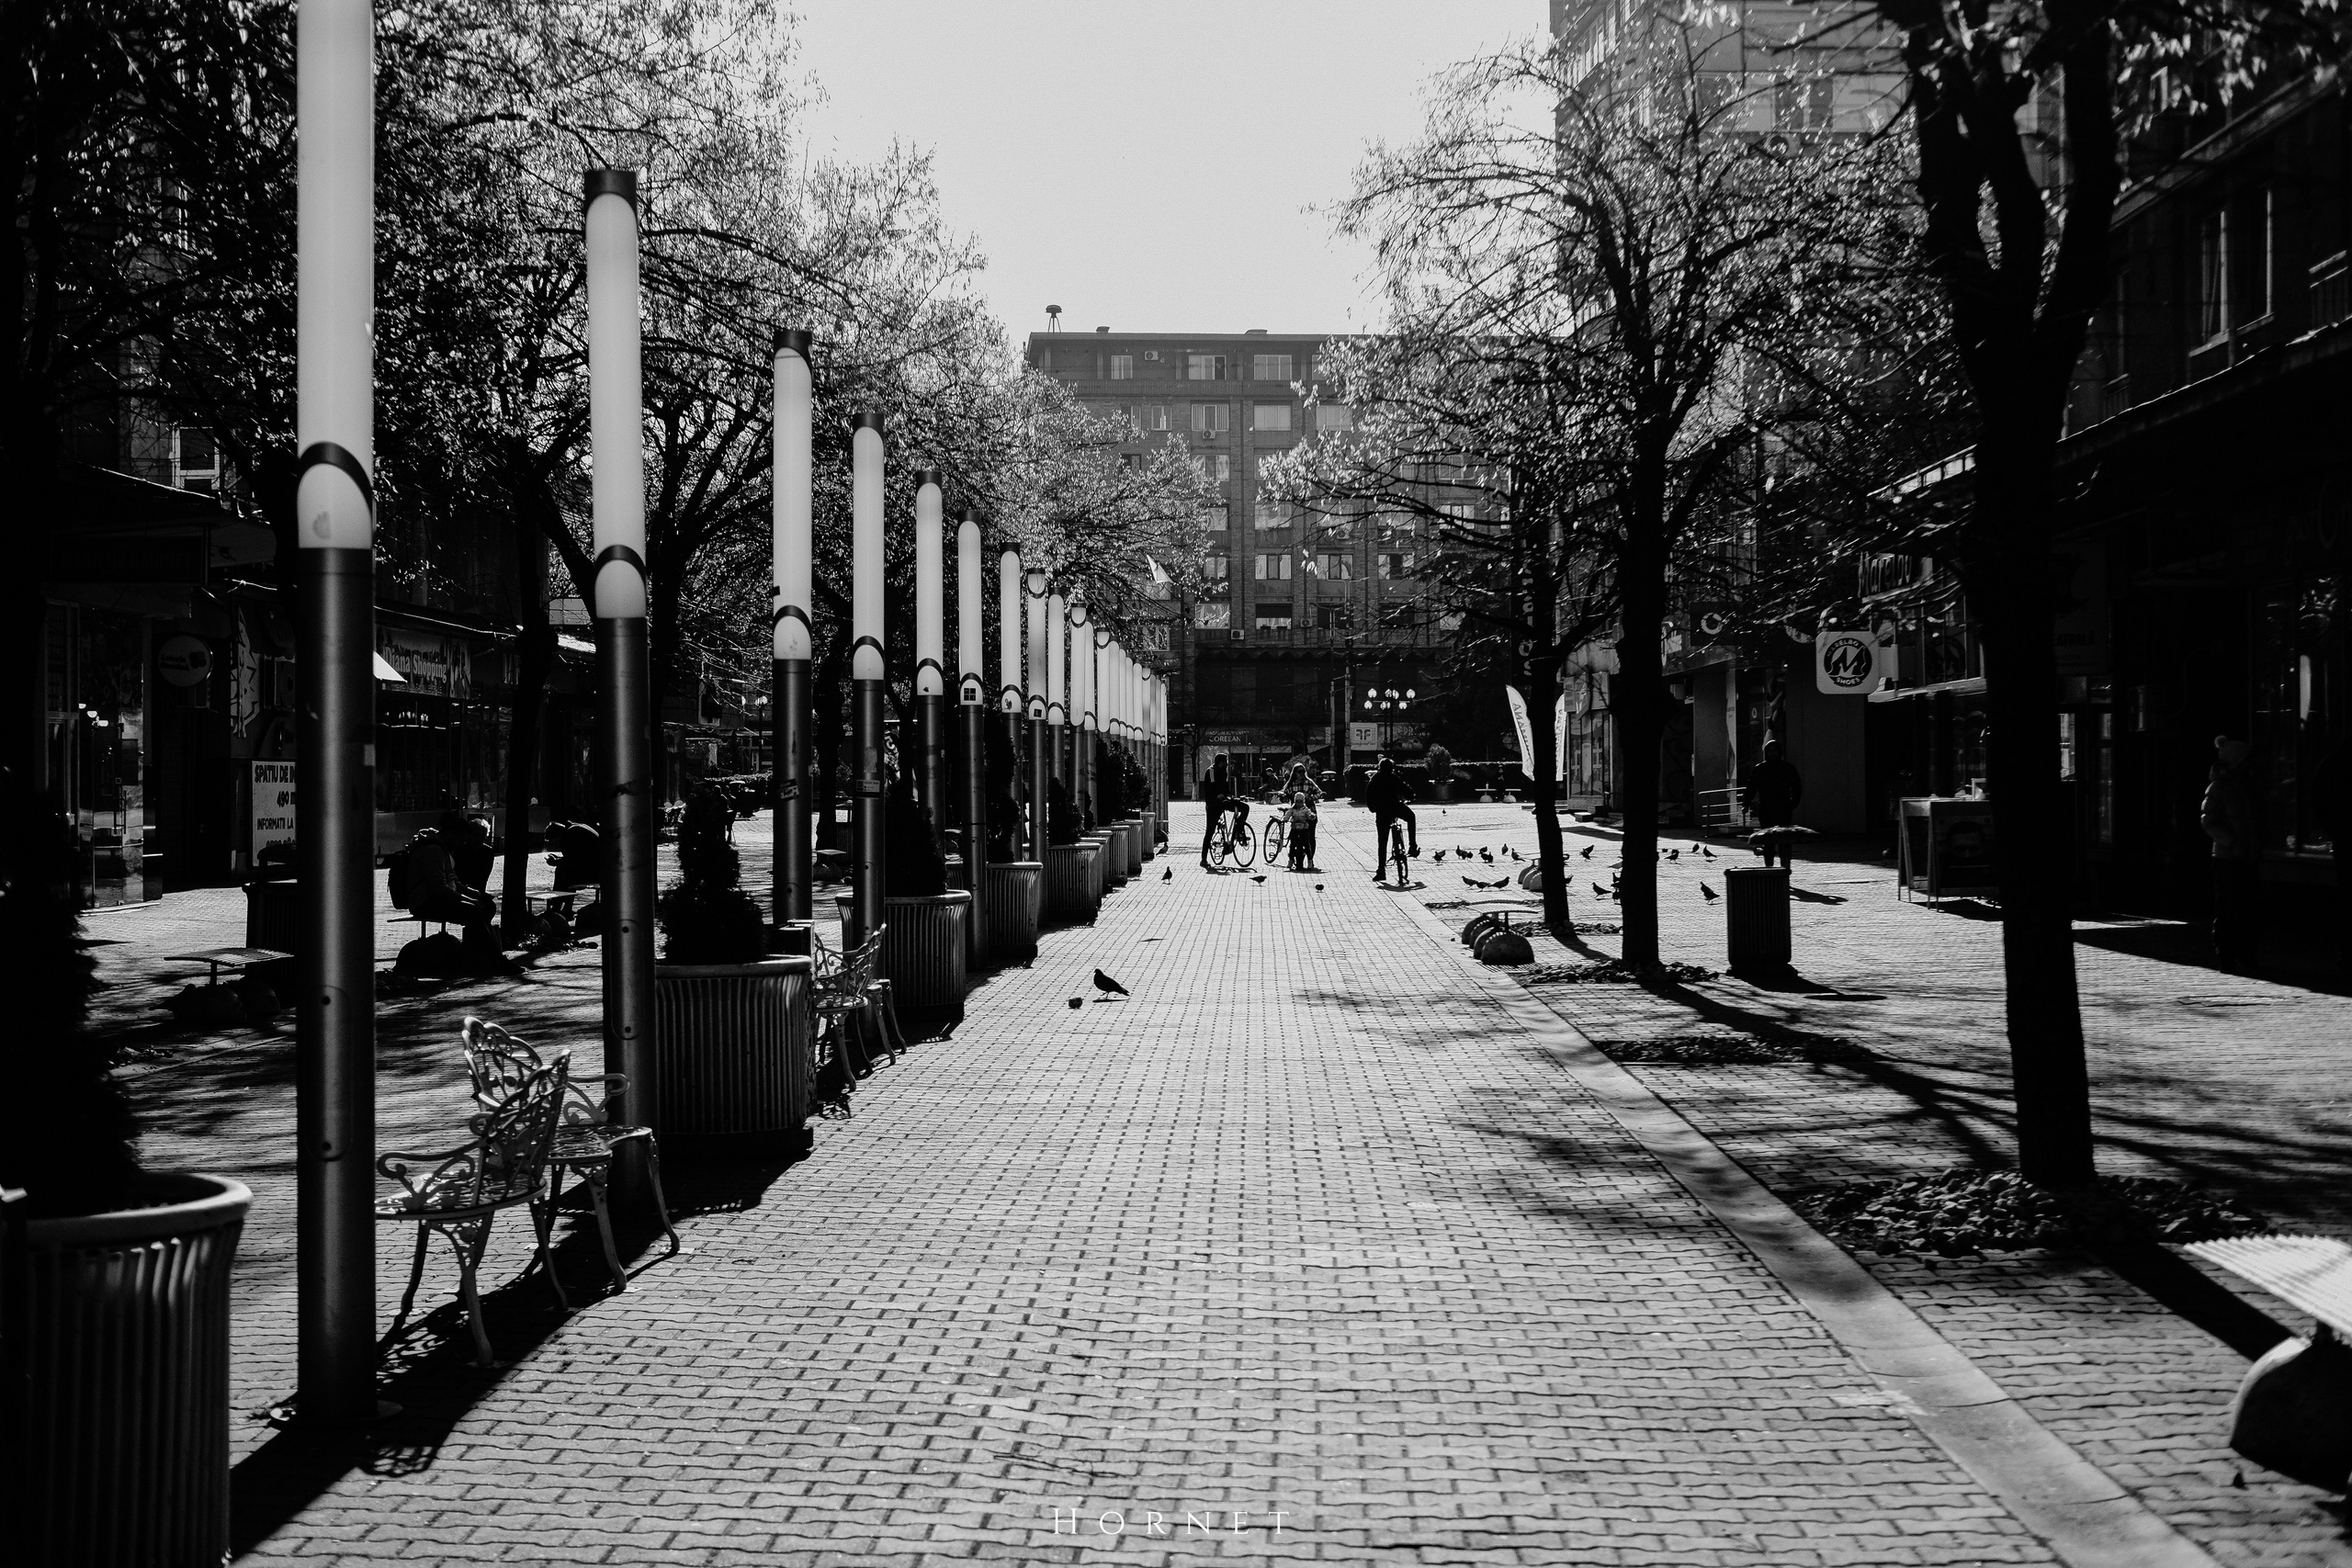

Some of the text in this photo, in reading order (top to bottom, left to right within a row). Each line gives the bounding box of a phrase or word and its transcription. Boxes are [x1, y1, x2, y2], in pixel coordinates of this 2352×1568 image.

[2051, 629, 2096, 646] EATRALĂ
[382, 647, 447, 683] Diana Shopping
[1837, 677, 1860, 685] SHOES
[254, 764, 278, 783] SPATIU
[279, 765, 288, 783] DE
[277, 790, 289, 807] 490
[288, 817, 294, 829] LA
